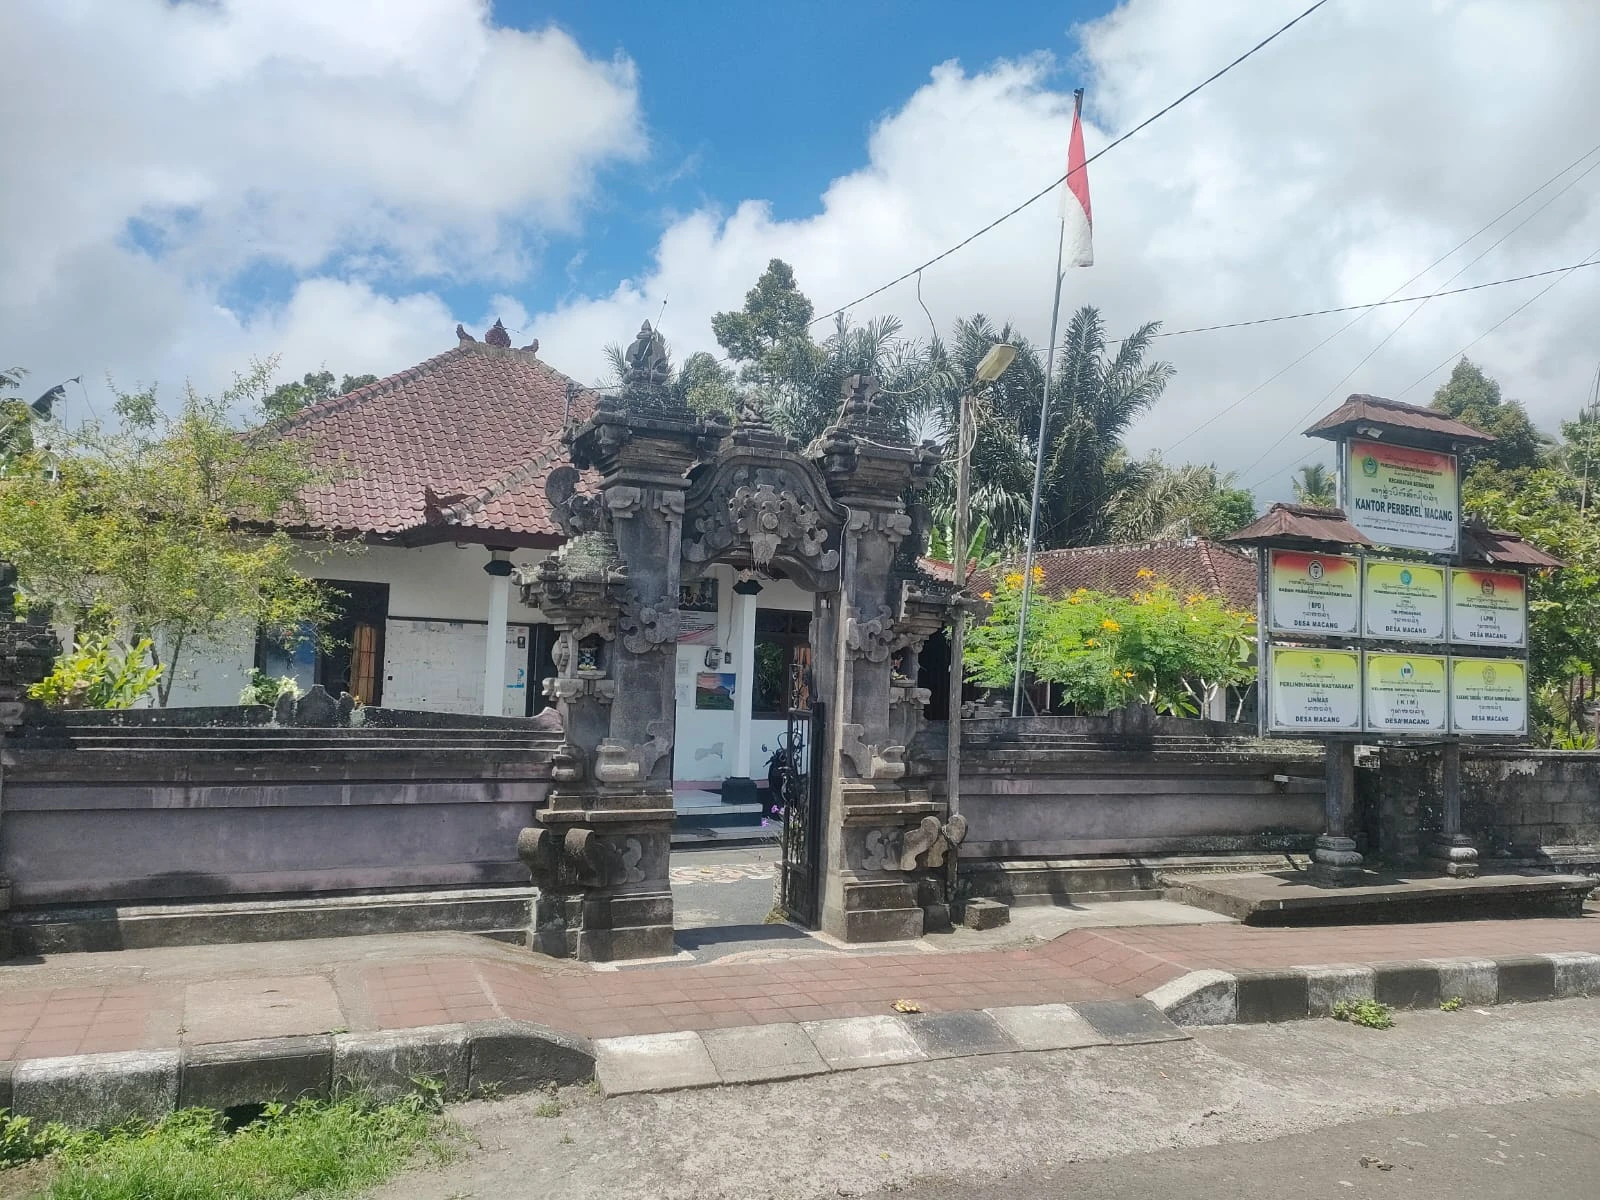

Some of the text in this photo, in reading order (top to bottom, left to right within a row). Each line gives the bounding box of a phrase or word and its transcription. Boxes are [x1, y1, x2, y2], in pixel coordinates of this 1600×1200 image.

[1355, 498, 1453, 521] KANTOR PERBEKEL MACANG
[1294, 619, 1310, 627] DESA
